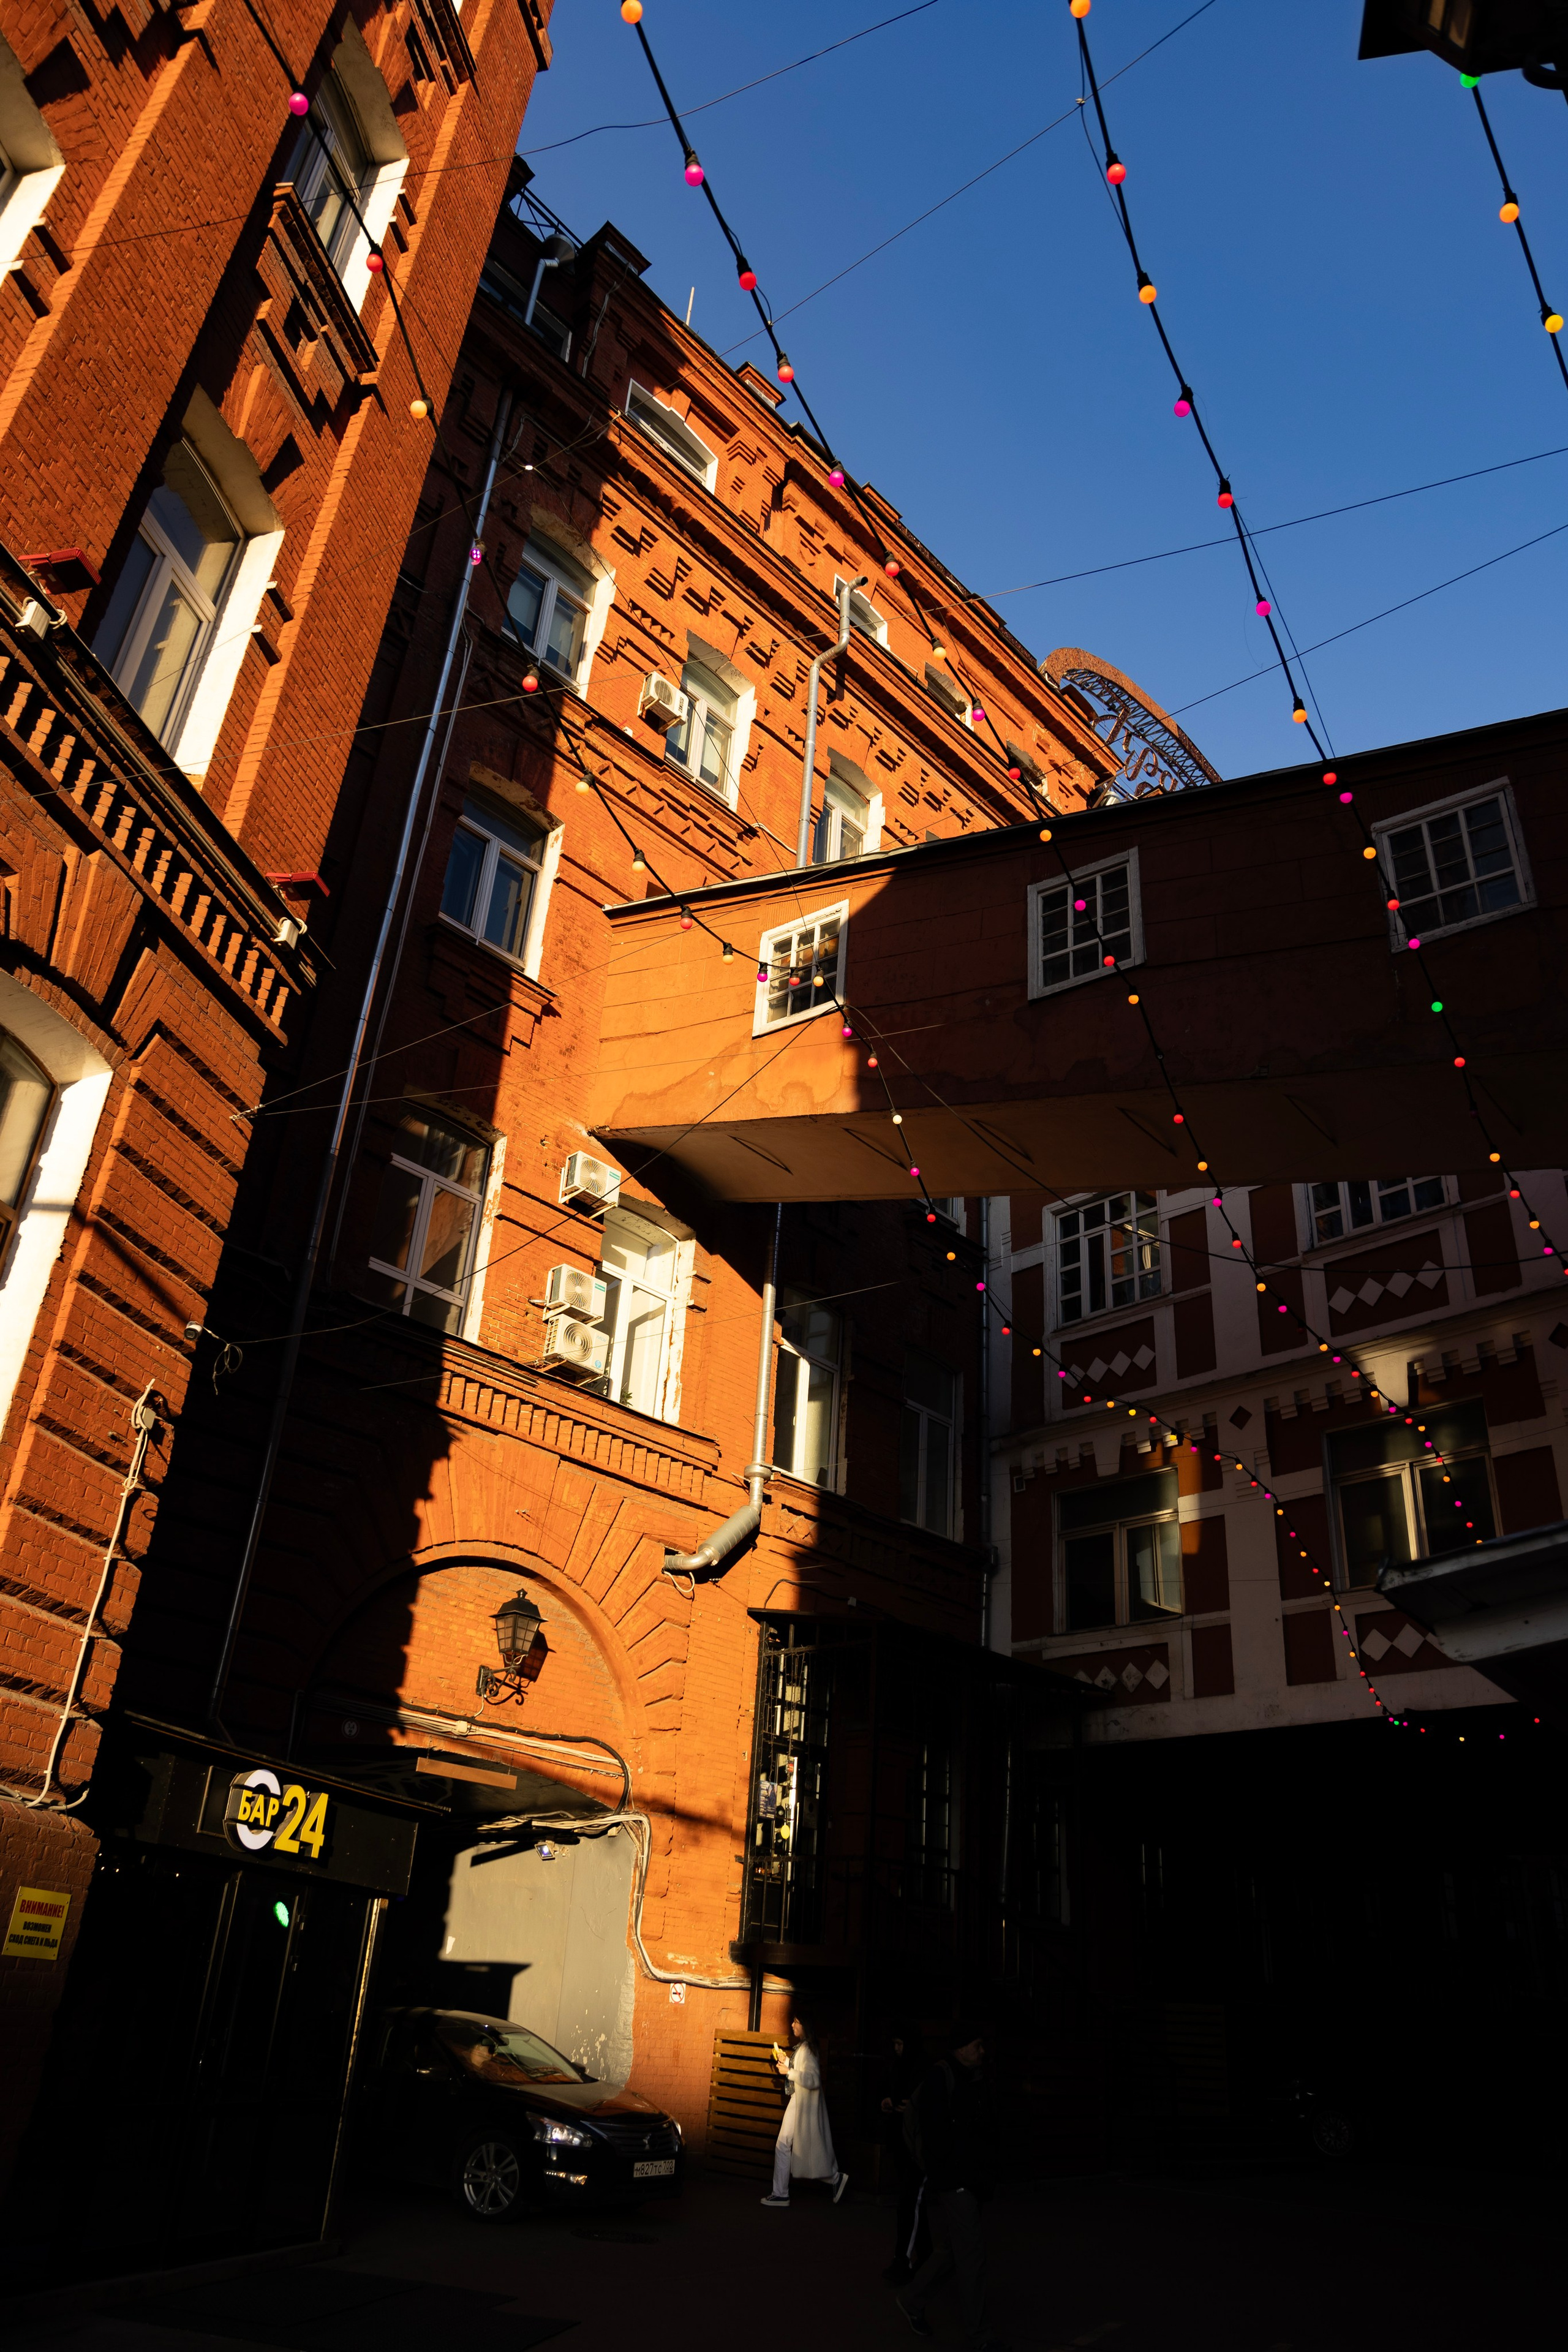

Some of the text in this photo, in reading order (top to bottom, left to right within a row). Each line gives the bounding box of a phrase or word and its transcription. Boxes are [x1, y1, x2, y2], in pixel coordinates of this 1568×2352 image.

[238, 1785, 329, 1859] БАР 24
[20, 1899, 65, 1918] ВНИМАНИЕ!
[23, 1921, 51, 1932] ВОЗМОЖЕН
[9, 1934, 58, 1948] СХОД СНЕГА И ЛЬДА
[663, 2161, 673, 2169] 702
